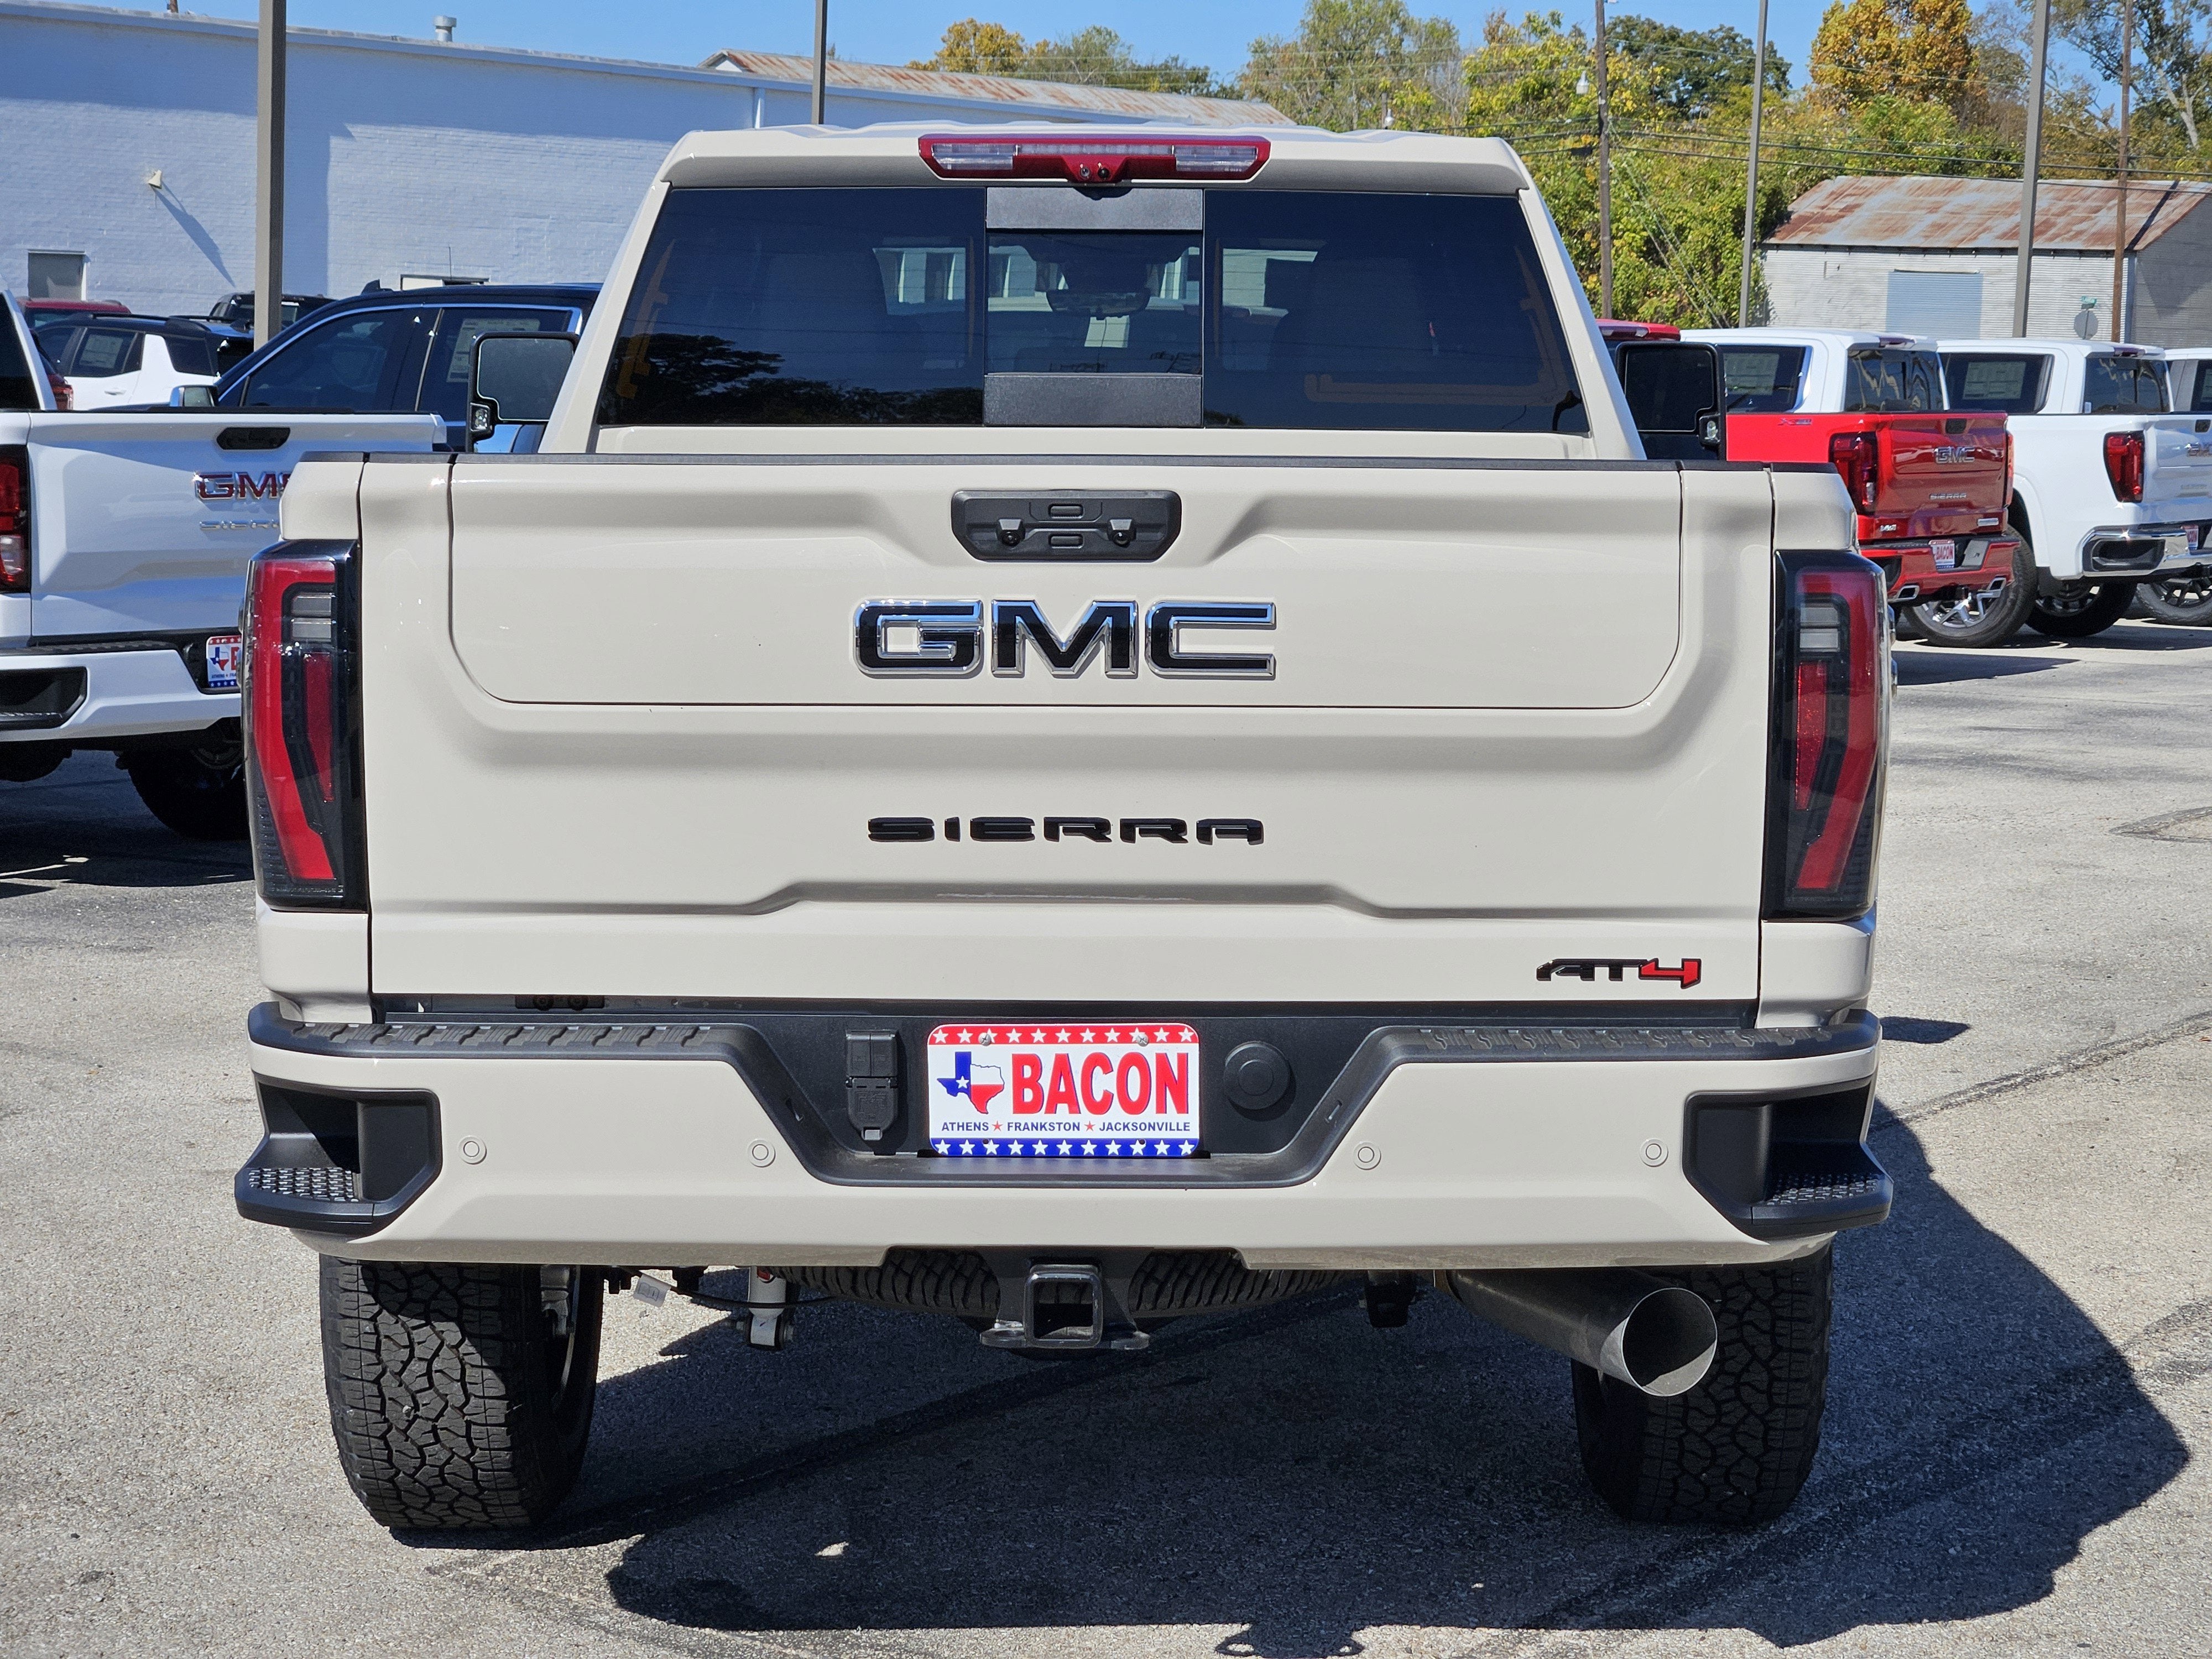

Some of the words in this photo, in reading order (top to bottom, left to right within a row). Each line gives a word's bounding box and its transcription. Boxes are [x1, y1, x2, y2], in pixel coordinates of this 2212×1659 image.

[1934, 446, 1975, 463] GMC
[854, 599, 1276, 679] GMC
[867, 816, 1264, 846] SIERRA
[1536, 958, 1702, 990] AT4
[1012, 1051, 1189, 1115] BACON
[941, 1121, 989, 1131] ATHENS
[1008, 1121, 1081, 1131] FRANKSTON
[1099, 1121, 1191, 1131] JACKSONVILLE
